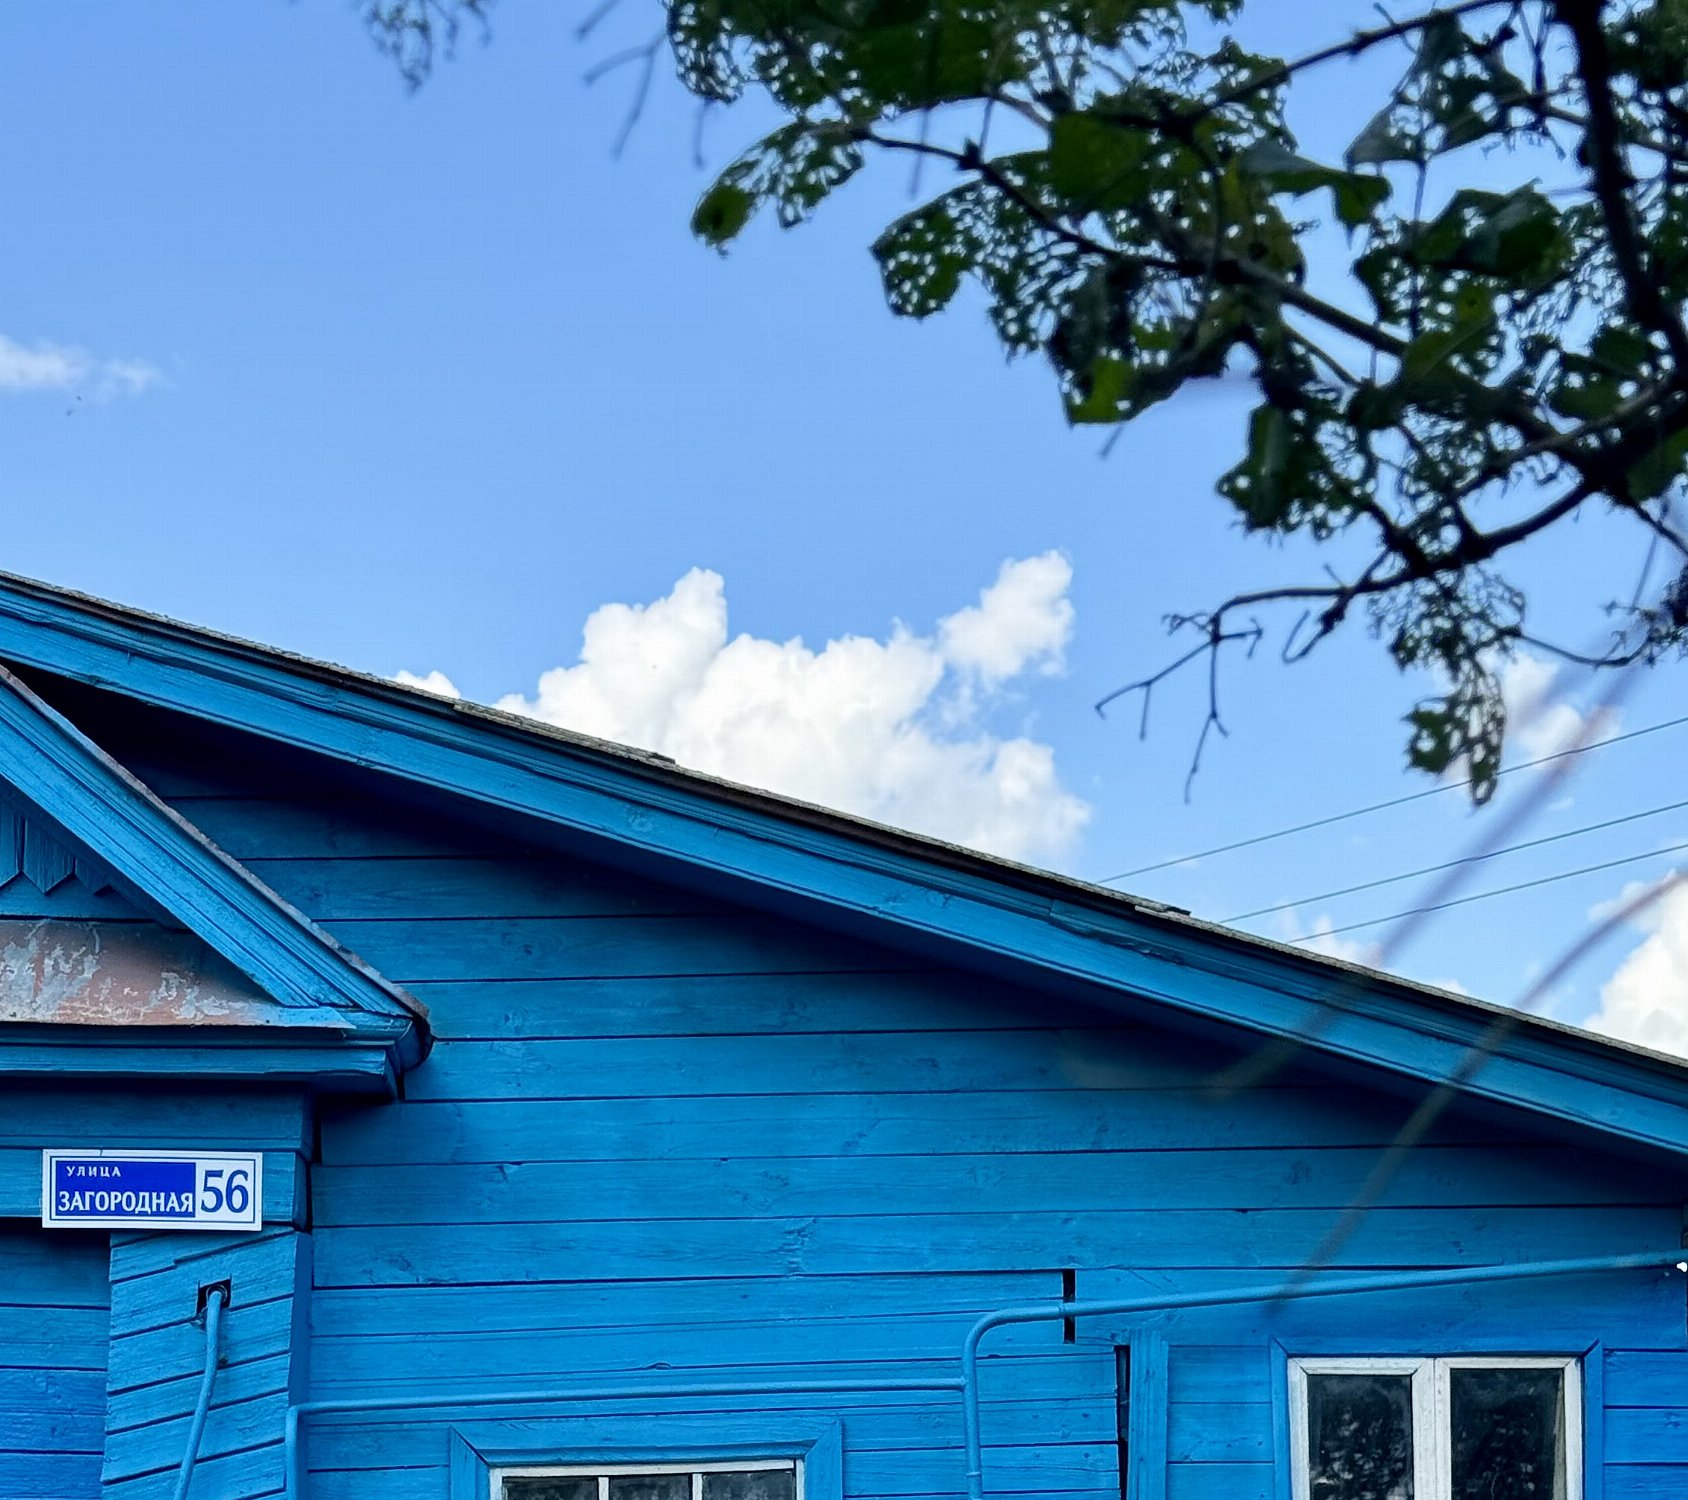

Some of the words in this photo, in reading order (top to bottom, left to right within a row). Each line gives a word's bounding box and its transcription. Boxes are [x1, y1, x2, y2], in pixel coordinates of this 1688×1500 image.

[66, 1166, 122, 1178] УЛИЦА
[58, 1190, 193, 1215] ЗАГОРОДНАЯ
[201, 1169, 249, 1213] 56
